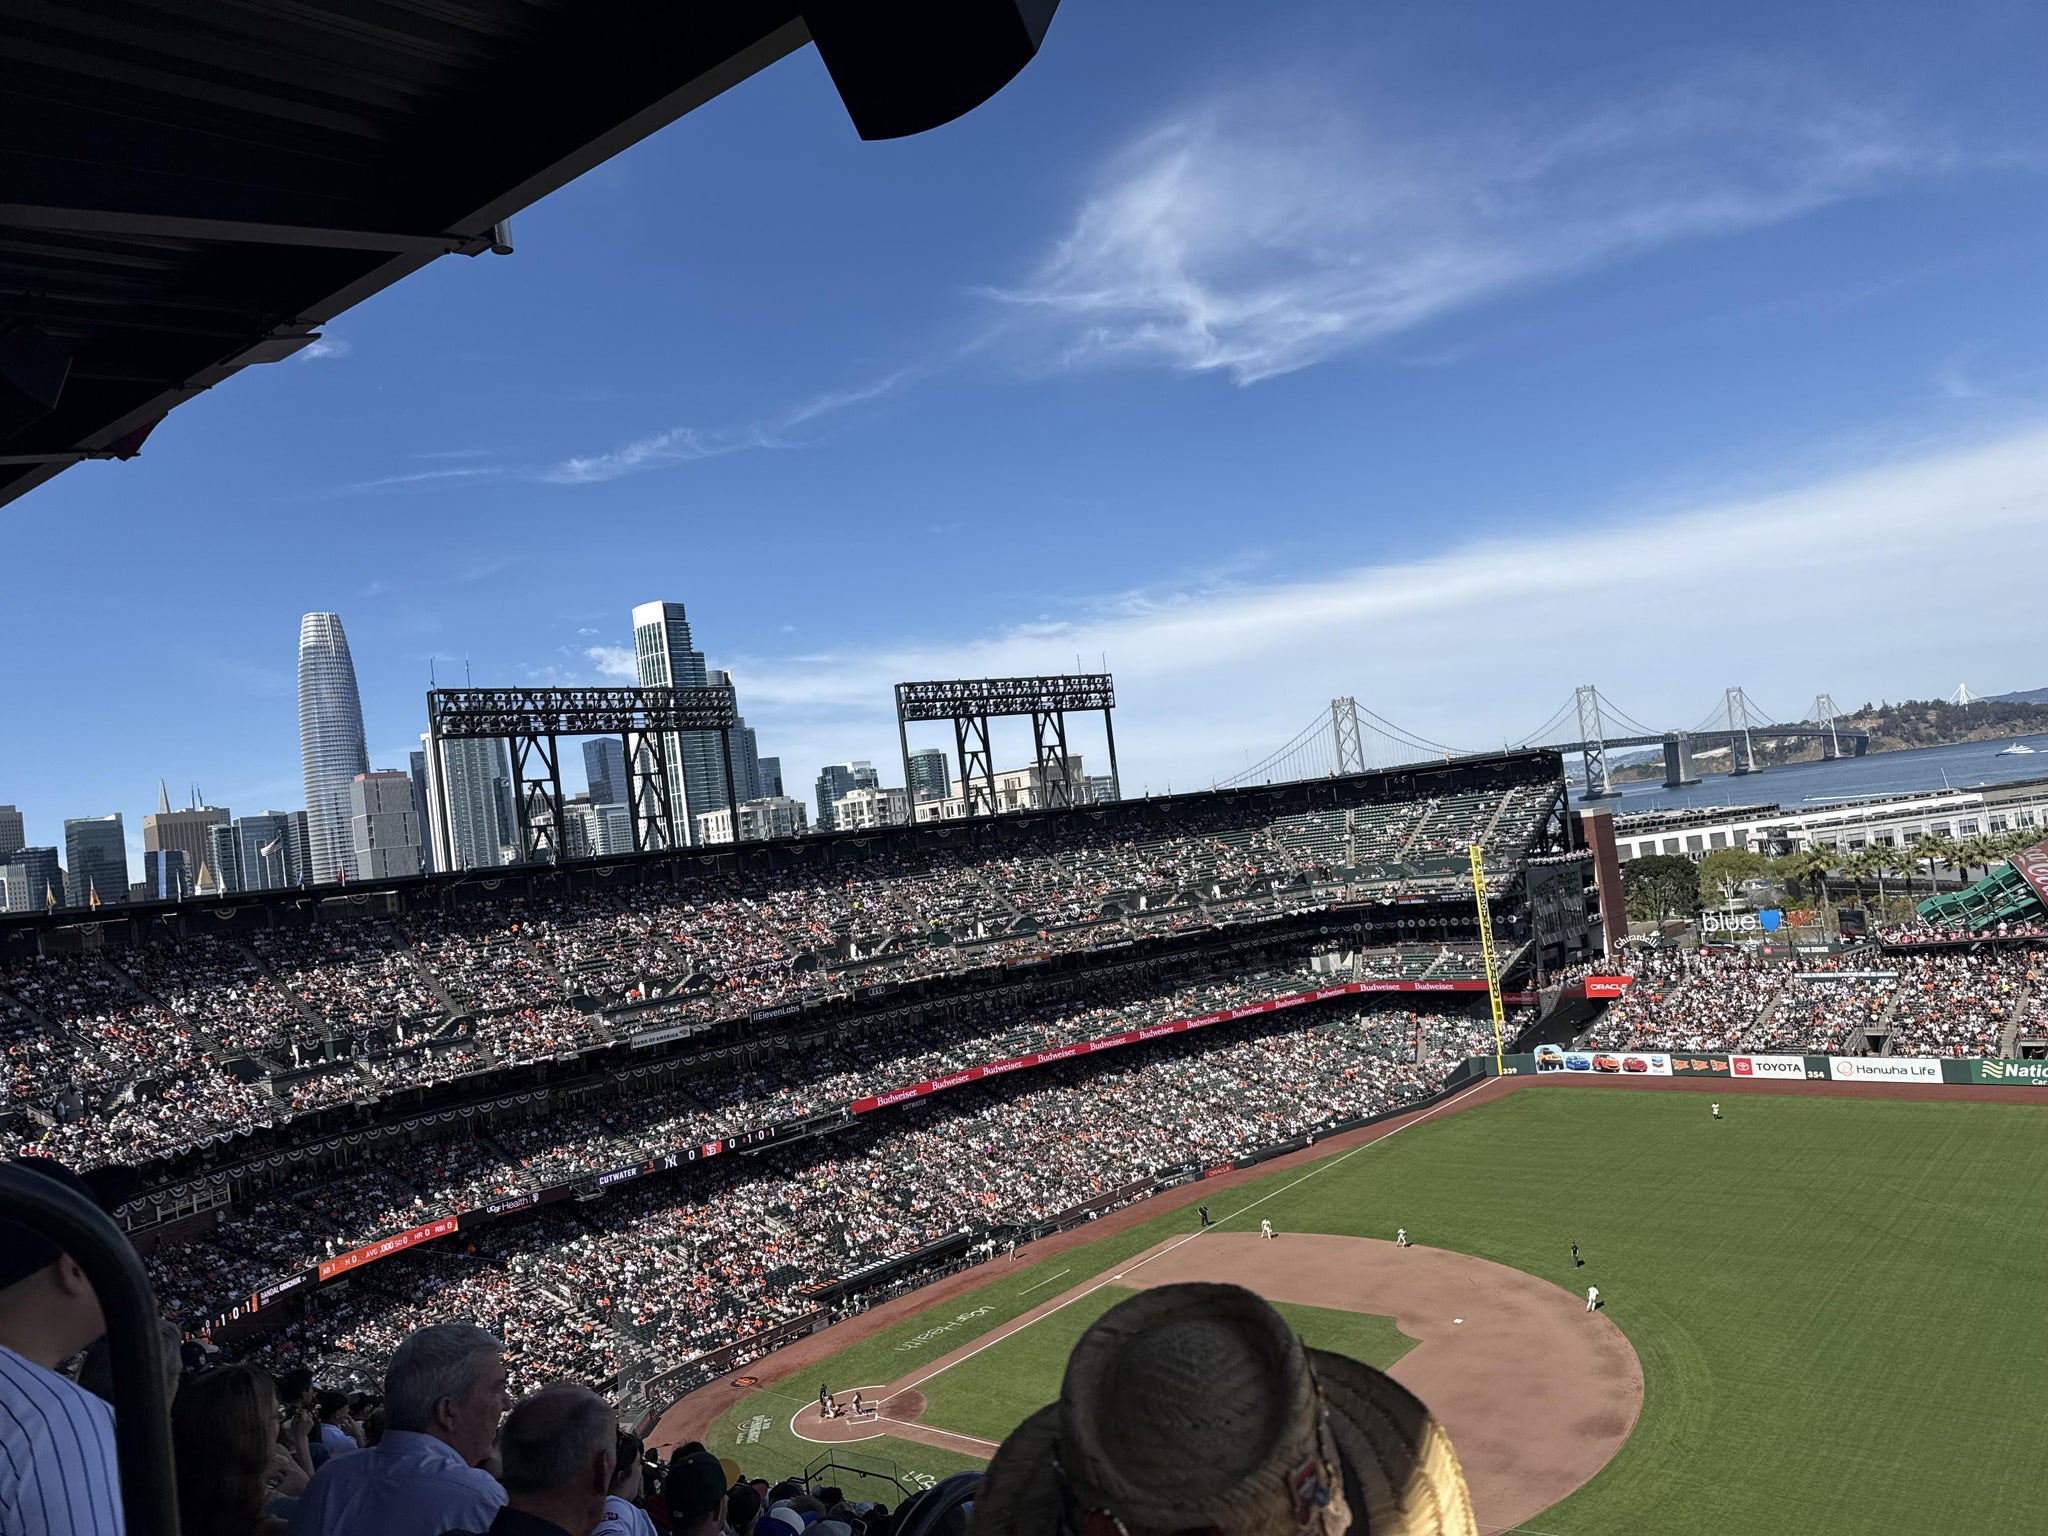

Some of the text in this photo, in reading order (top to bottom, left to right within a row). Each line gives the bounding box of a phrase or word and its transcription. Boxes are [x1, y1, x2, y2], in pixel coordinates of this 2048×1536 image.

[1702, 911, 1756, 932] blue
[1613, 932, 1660, 949] Ghirardelli
[656, 1032, 679, 1042] AMERICA
[1502, 1067, 1518, 1075] 339
[1756, 1063, 1801, 1072] TOYOTA
[1856, 1065, 1936, 1076] Hanwha Life
[2031, 1078, 2047, 1086] Car
[758, 1130, 765, 1140] 0
[688, 1150, 695, 1160] 0
[729, 1138, 736, 1149] 0
[599, 1167, 637, 1185] CUTWATER
[501, 1197, 529, 1211] Health
[323, 1265, 331, 1276] AB
[351, 1255, 357, 1263] 0
[366, 1249, 378, 1258] AVG
[402, 1236, 408, 1245] 0
[414, 1231, 423, 1240] HR
[424, 1228, 431, 1237] 0
[447, 1221, 453, 1229] 0
[220, 1313, 226, 1326] 1
[232, 1306, 239, 1320] 0
[245, 1300, 250, 1313] 1
[894, 1321, 962, 1351] Health
